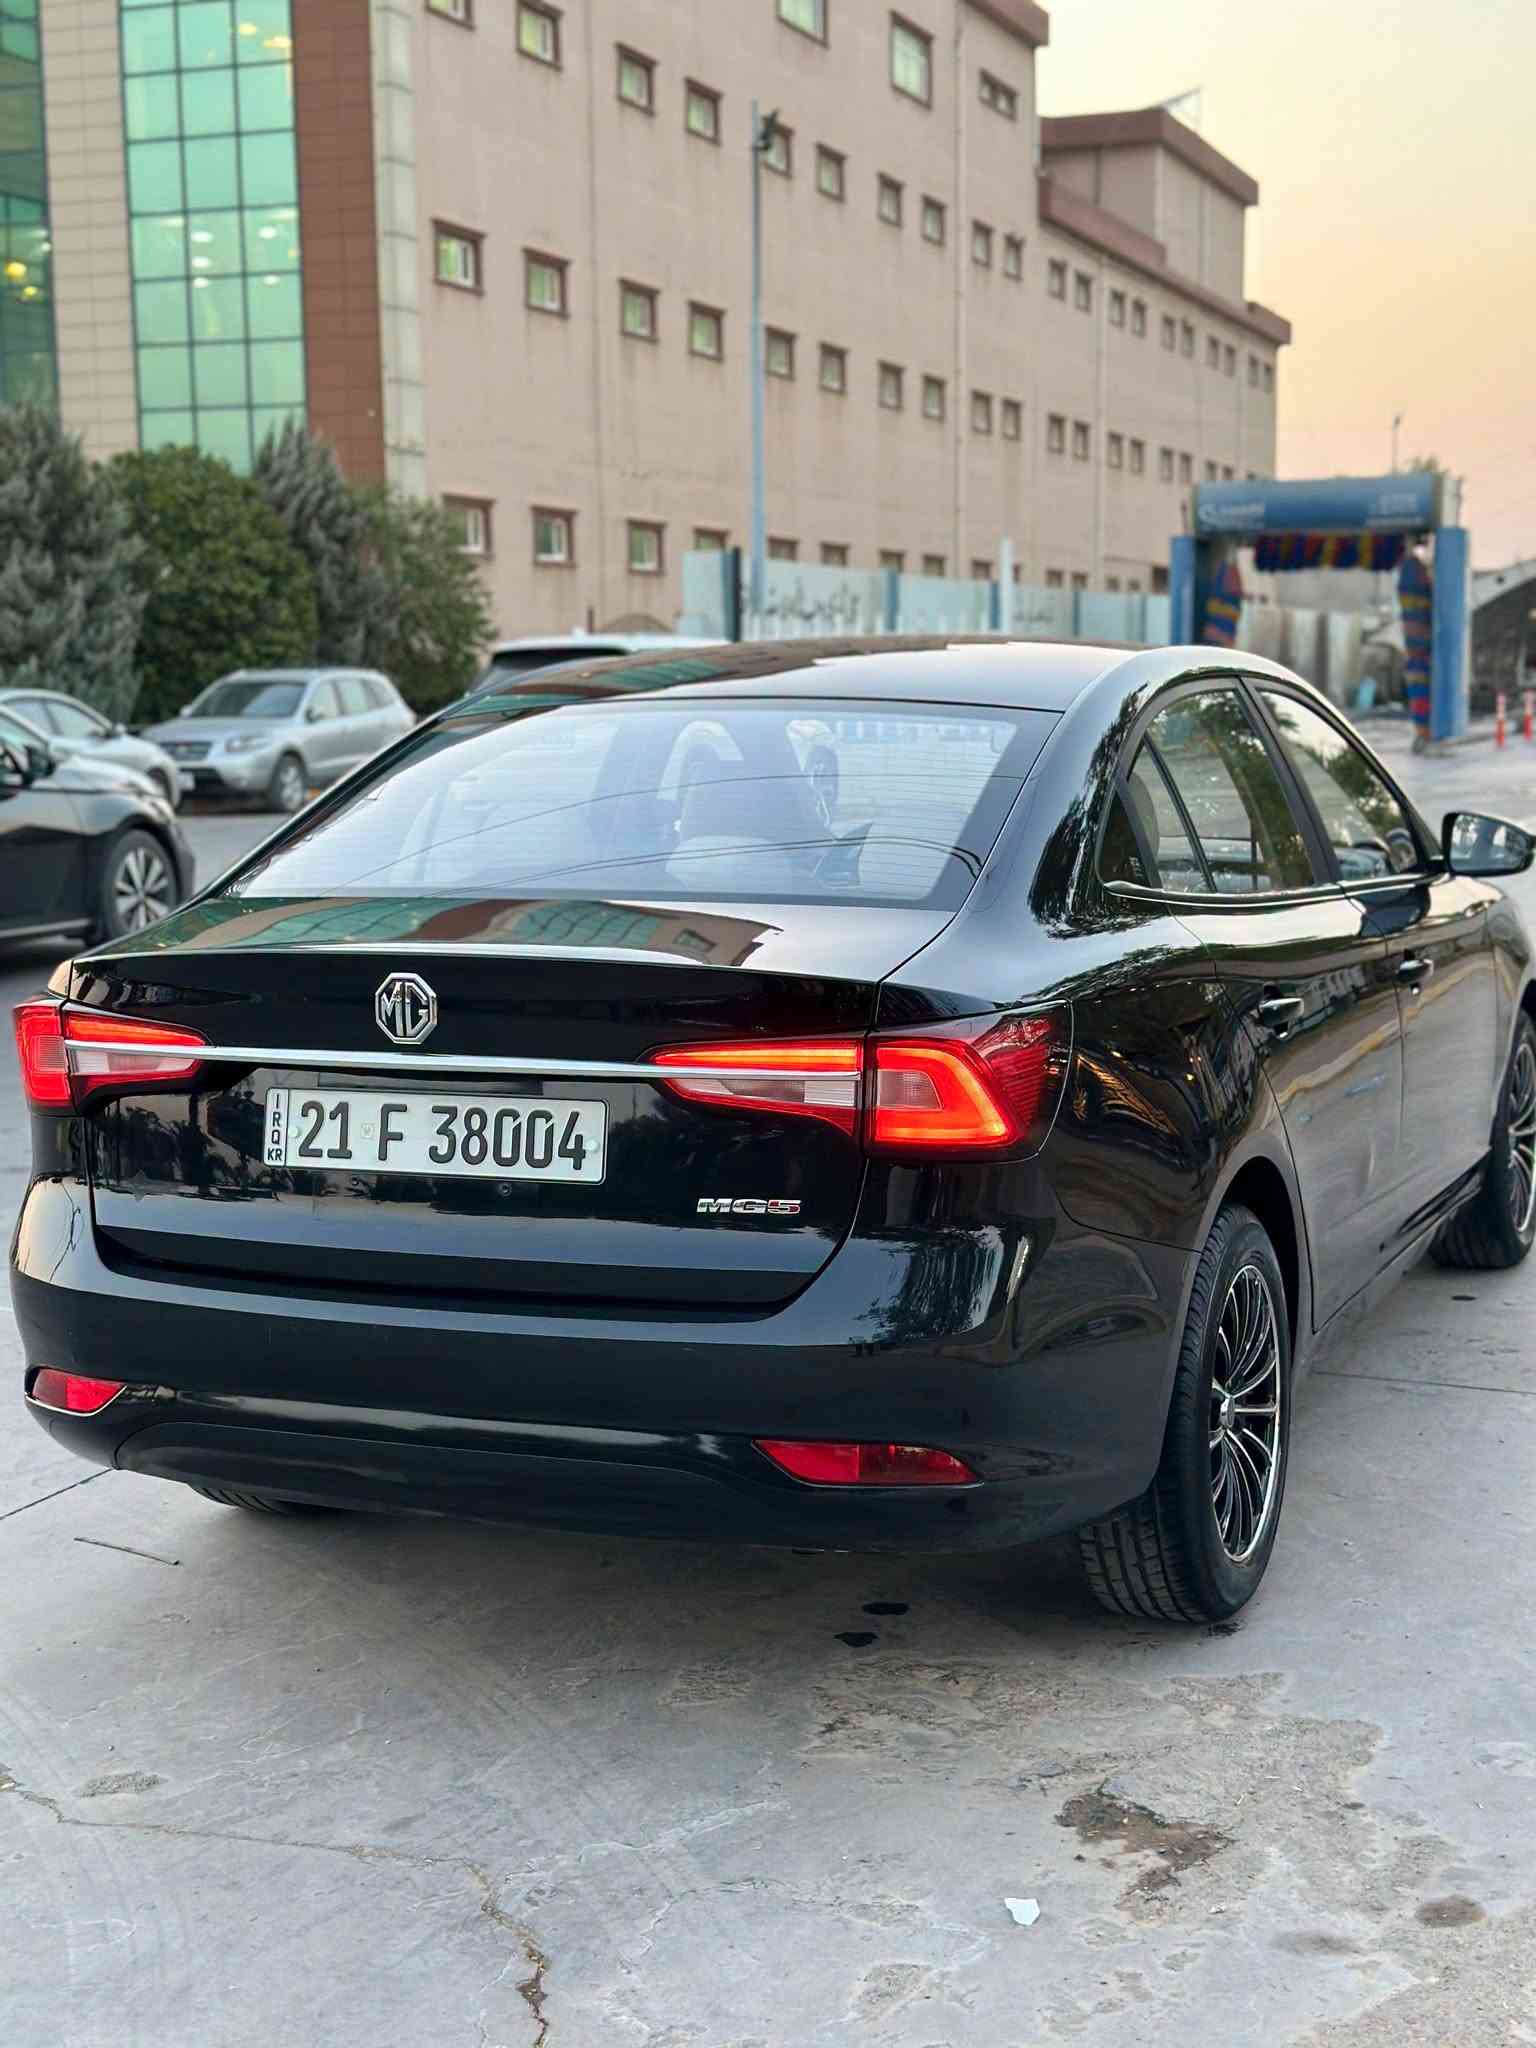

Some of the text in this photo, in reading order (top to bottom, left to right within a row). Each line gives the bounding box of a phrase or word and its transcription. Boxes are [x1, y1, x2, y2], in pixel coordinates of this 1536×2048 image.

[379, 979, 431, 1038] MG
[298, 1101, 588, 1170] 21 F 38004
[267, 1148, 283, 1161] KR
[696, 1198, 802, 1214] MG5
